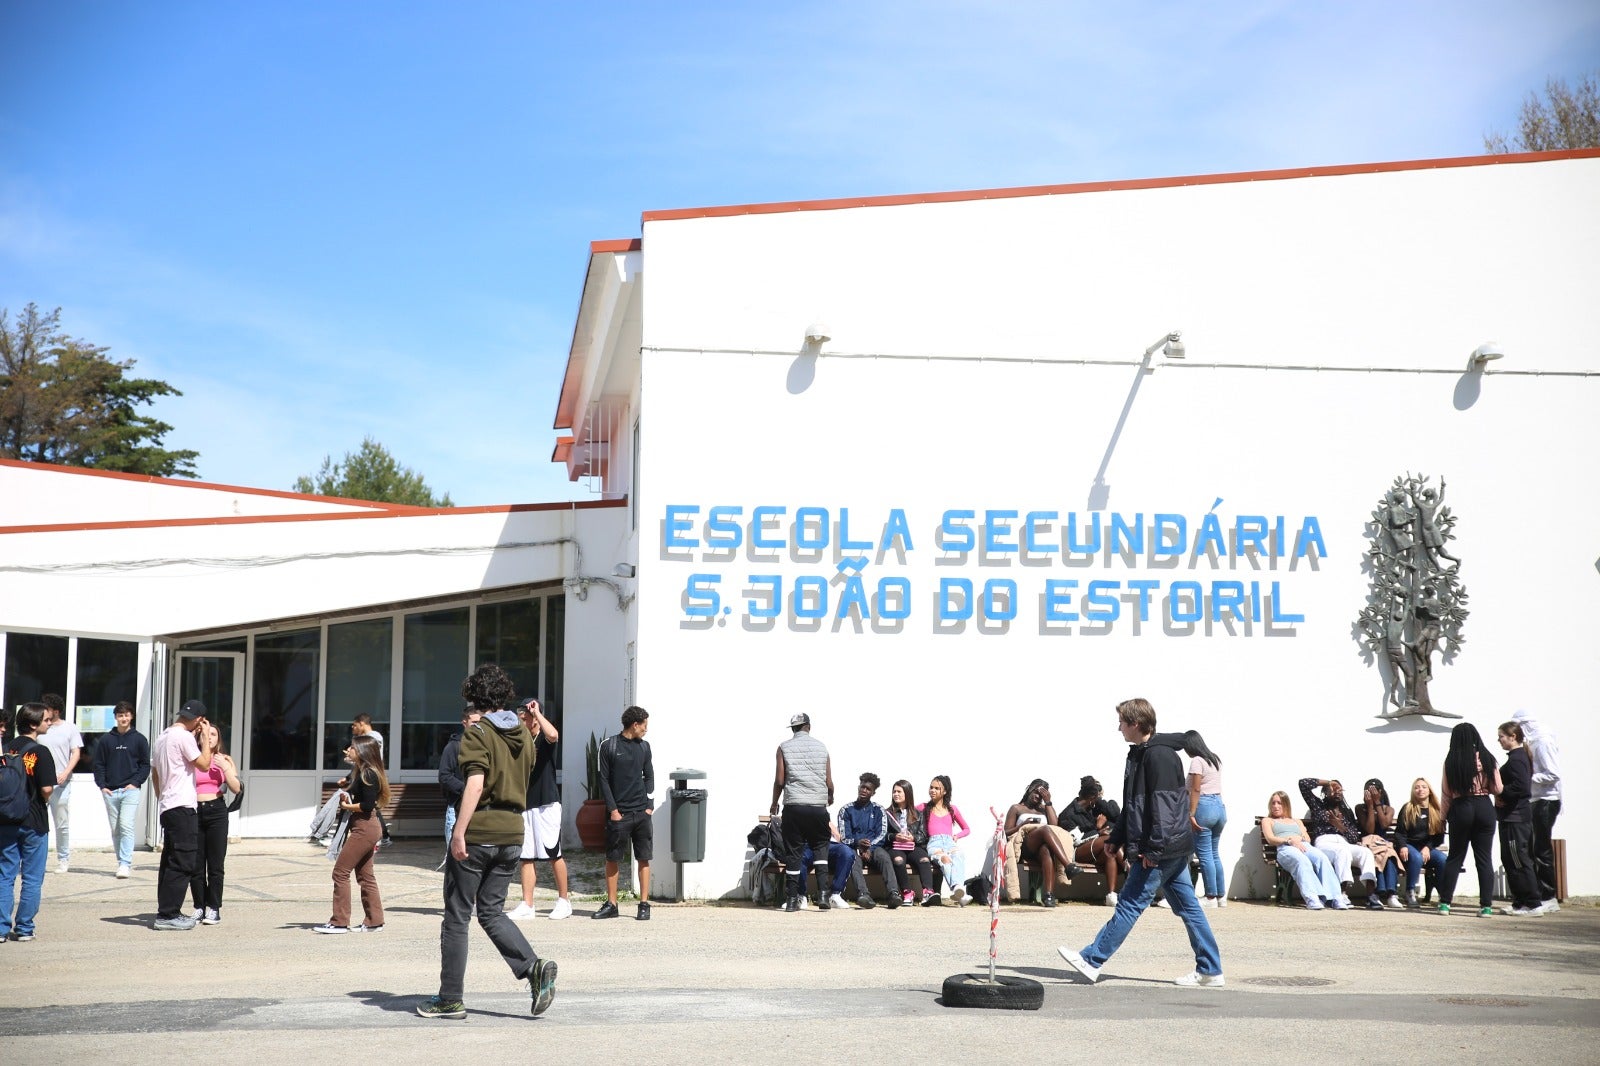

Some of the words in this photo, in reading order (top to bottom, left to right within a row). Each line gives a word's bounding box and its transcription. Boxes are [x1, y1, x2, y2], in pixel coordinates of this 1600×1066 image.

[665, 504, 914, 551] ESCOLA
[941, 497, 1328, 558] SECUNDÁRIA
[685, 573, 732, 617] S.
[748, 555, 912, 620] JOÃO
[940, 577, 1018, 621] DO
[1045, 579, 1305, 623] ESTORIL
